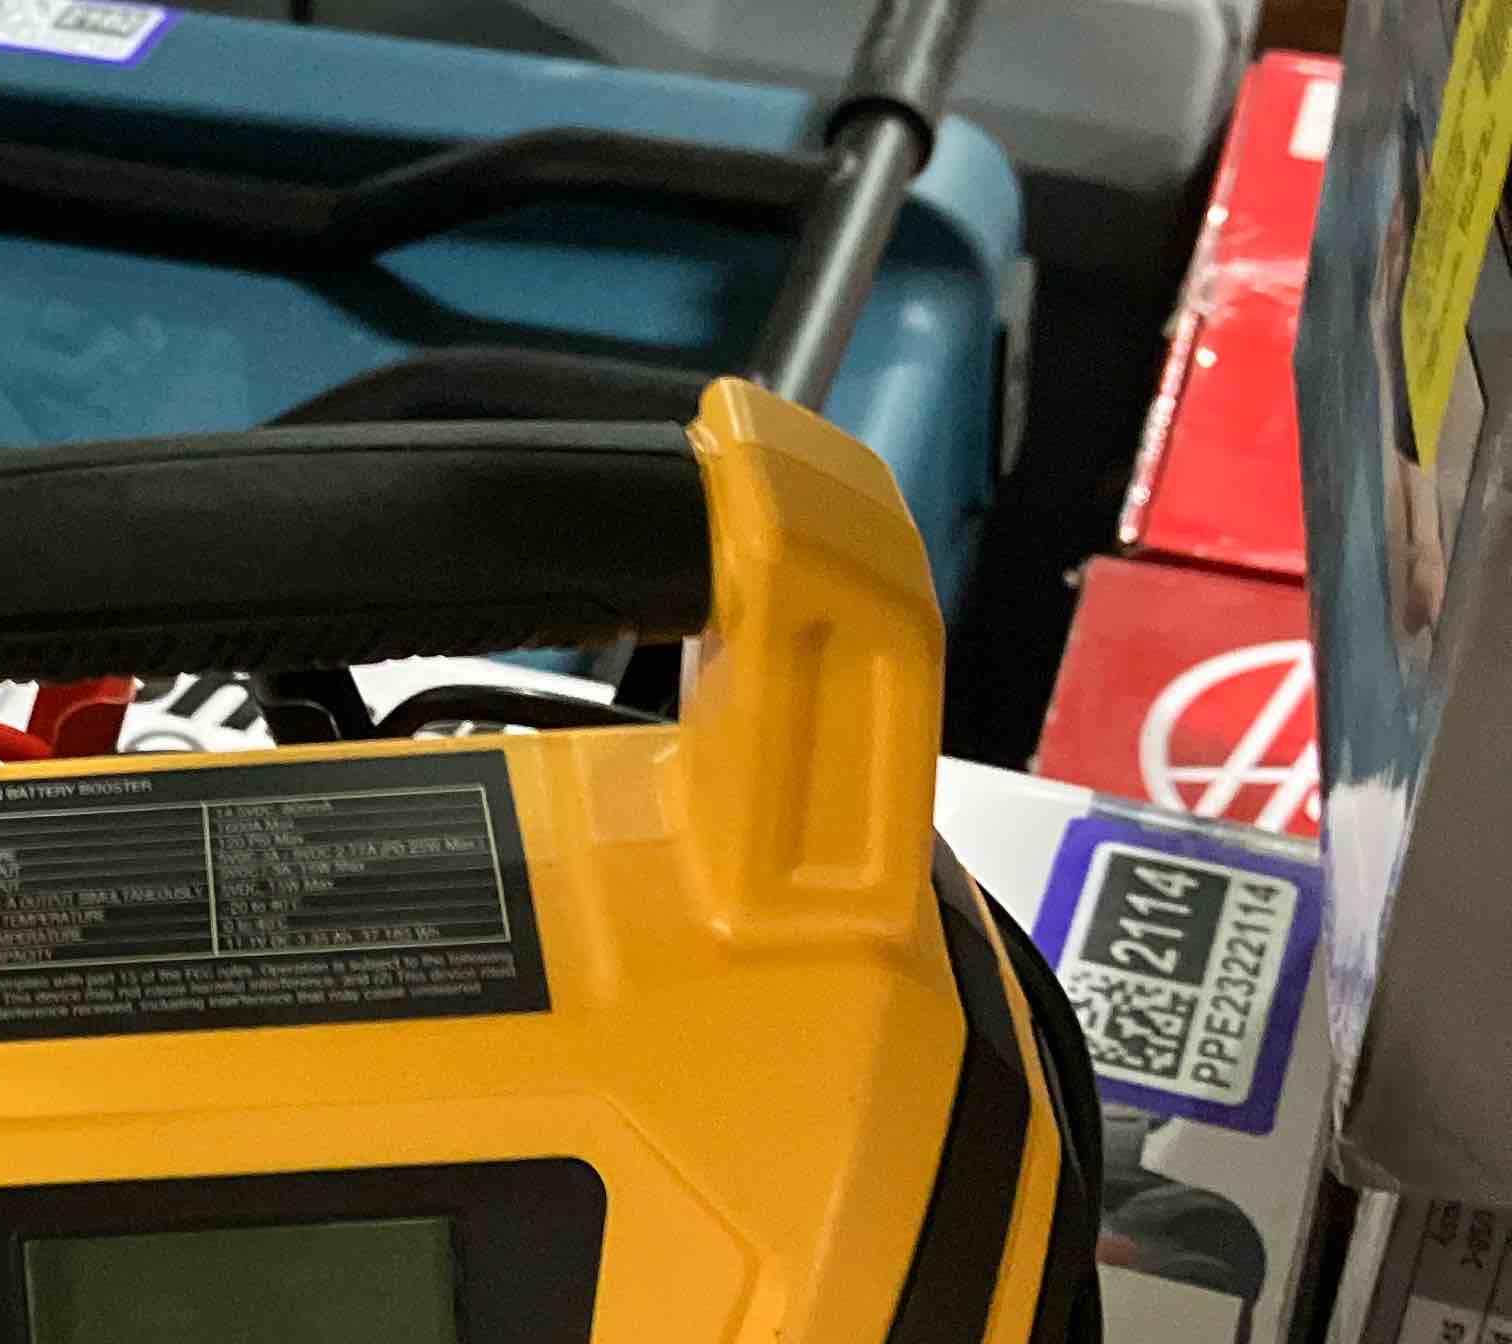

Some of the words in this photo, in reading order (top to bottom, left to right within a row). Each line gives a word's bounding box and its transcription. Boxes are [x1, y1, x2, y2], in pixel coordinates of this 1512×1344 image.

[6, 782, 77, 801] BATTERY
[79, 779, 153, 796] BOOSTER
[1109, 863, 1199, 975] 2114
[1189, 881, 1283, 1091] PPE2322114
